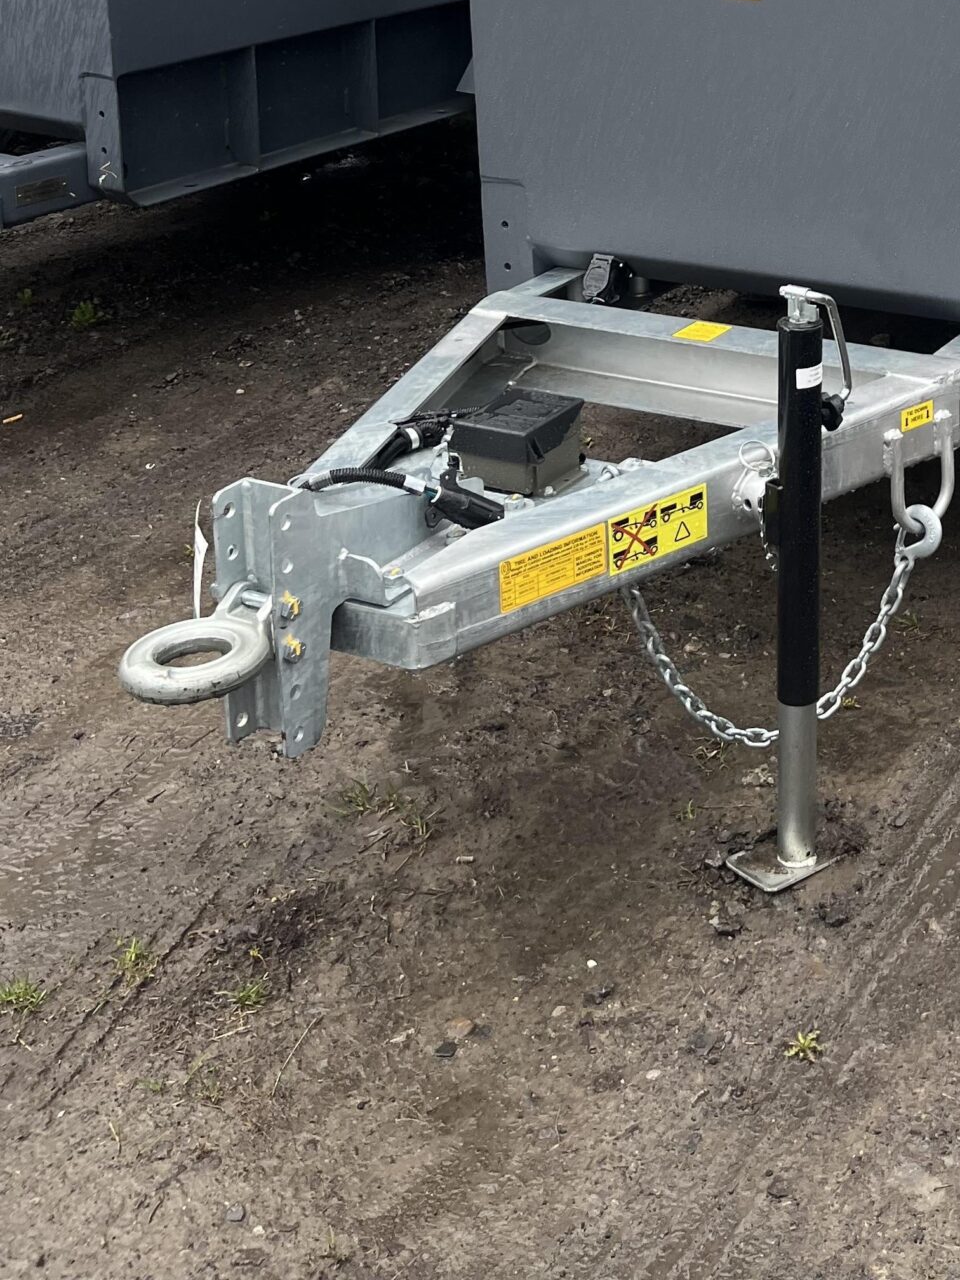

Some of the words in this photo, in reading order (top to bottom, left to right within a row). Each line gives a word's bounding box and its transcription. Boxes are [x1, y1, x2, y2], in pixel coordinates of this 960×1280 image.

[527, 553, 539, 561] AND
[539, 544, 563, 557] LOADING
[563, 530, 598, 548] INFORMATION
